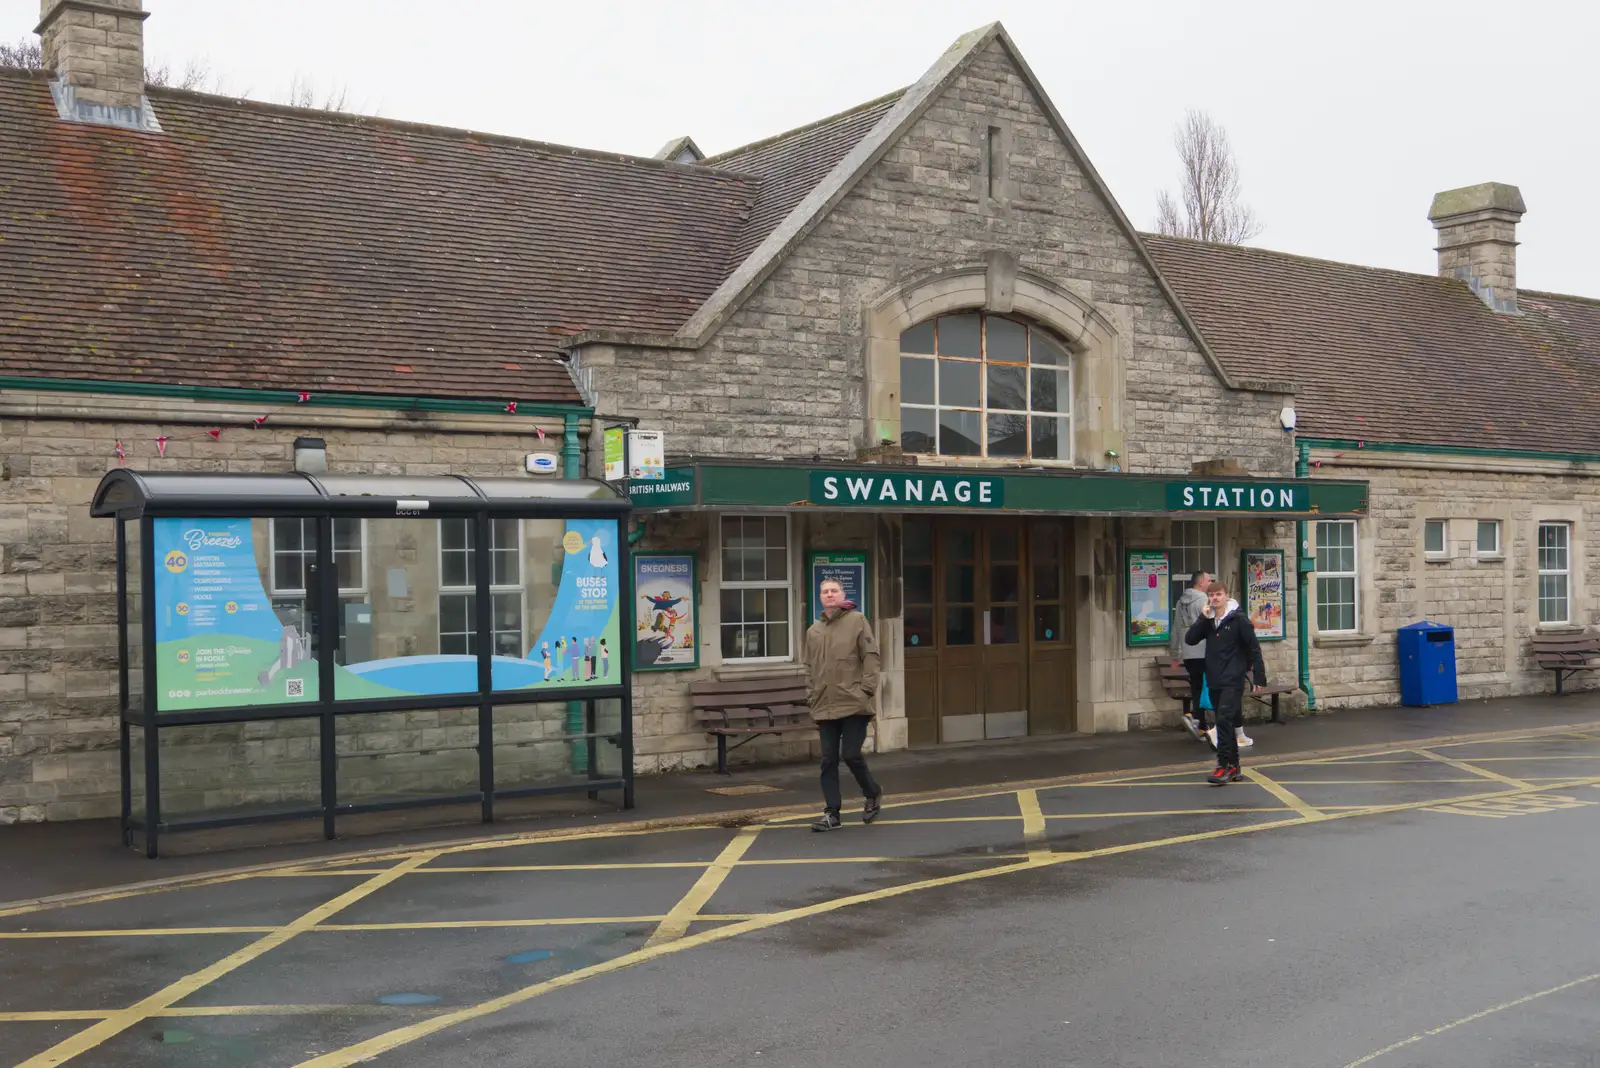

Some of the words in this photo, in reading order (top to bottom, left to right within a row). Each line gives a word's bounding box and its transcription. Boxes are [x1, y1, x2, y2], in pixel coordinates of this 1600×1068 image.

[655, 481, 690, 493] RAILWAYS
[823, 475, 993, 504] SWANAGE
[1183, 486, 1295, 508] STATION
[183, 528, 242, 551] Breezer
[166, 556, 187, 567] 40
[640, 563, 688, 573] SKEGNESS
[576, 576, 607, 588] BUSES
[1249, 580, 1281, 594] Torquay
[581, 587, 607, 598] STOP
